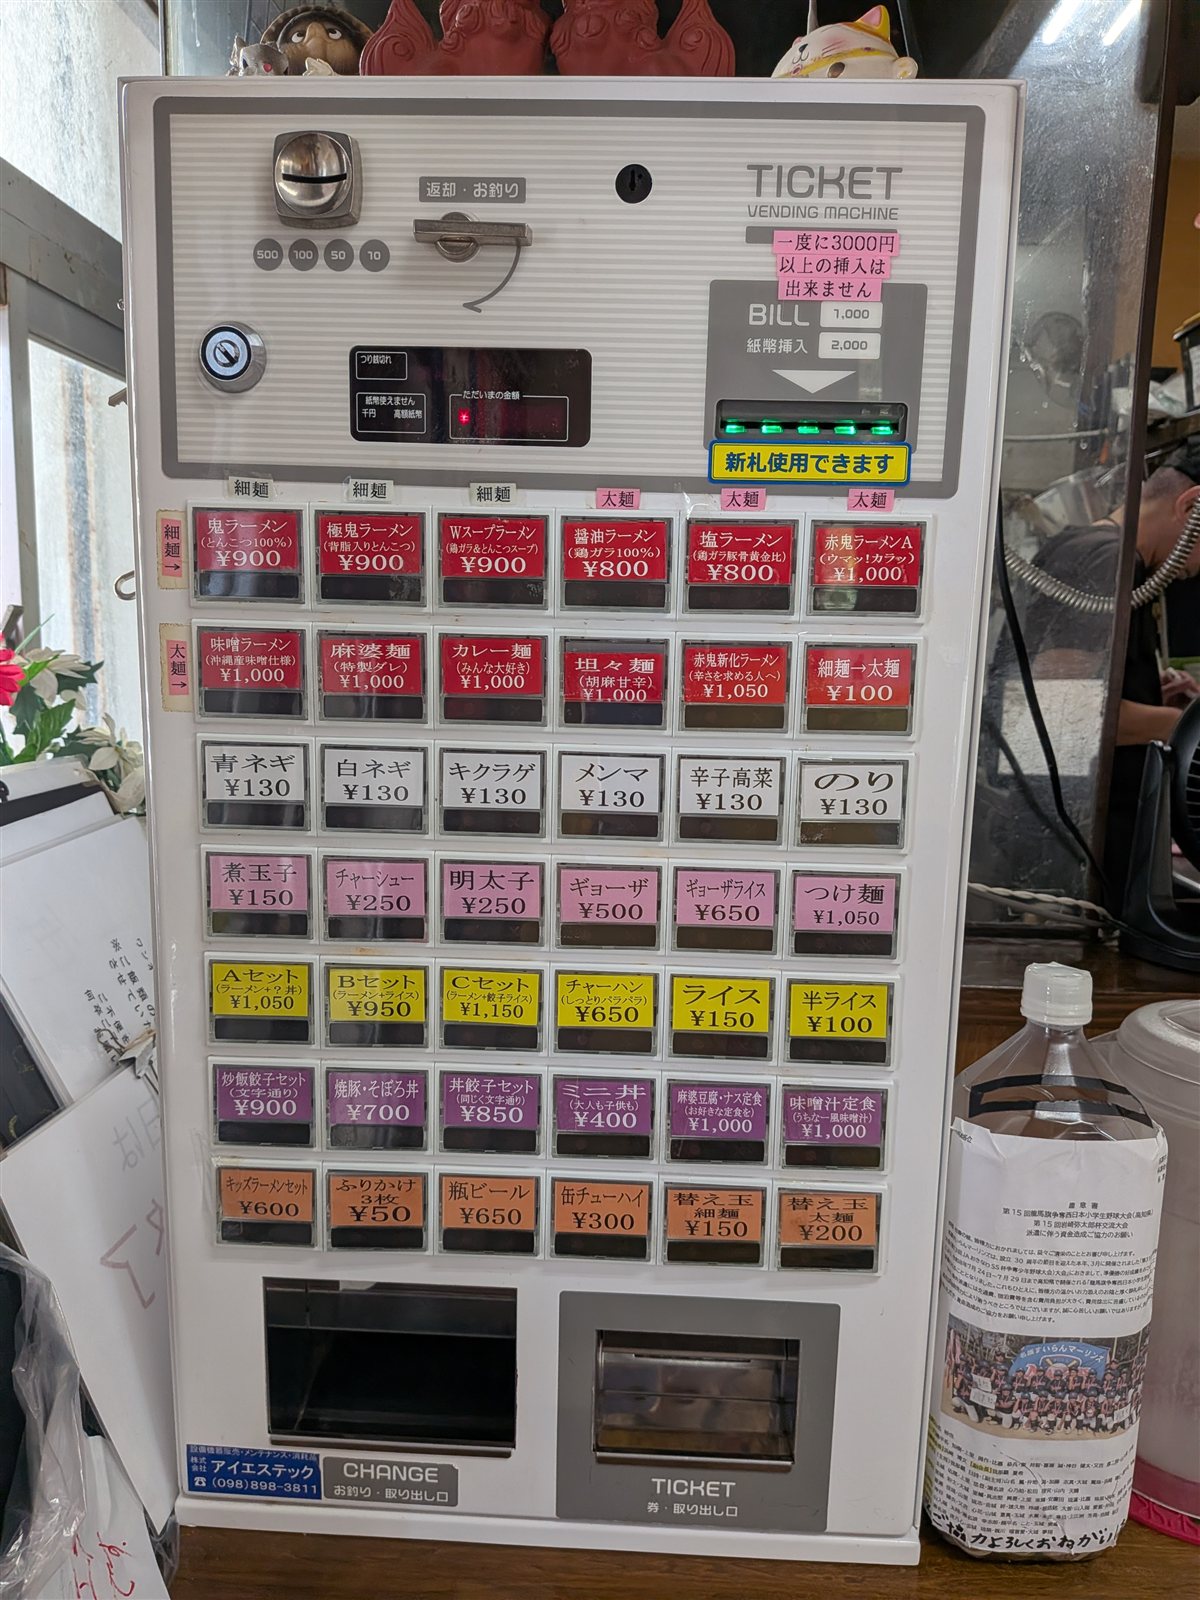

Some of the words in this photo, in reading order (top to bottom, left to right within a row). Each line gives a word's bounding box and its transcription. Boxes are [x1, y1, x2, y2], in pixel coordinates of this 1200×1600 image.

[747, 165, 903, 200] TICKET
[748, 205, 818, 218] VENDING
[824, 206, 899, 220] MACHINE
[778, 233, 894, 253] 一度に3000円
[257, 249, 278, 259] 500
[293, 250, 313, 259] 100
[331, 251, 346, 260] 50
[368, 251, 381, 260] 10
[779, 256, 885, 275] 以上の挿入は
[785, 280, 871, 298] 出来ません
[749, 304, 809, 326] BILL
[834, 309, 869, 319] 1,000
[747, 338, 808, 354] 紙幣挿入
[831, 340, 868, 351] 2,000
[365, 396, 415, 405] 紙幣使えません
[463, 390, 520, 400] ただいまの金額
[362, 409, 376, 418] 千円
[394, 409, 422, 419] 高額紙幣
[725, 452, 894, 474] 新札使用できます
[234, 480, 269, 497] 細麺
[353, 481, 387, 498] 細麺
[476, 486, 510, 502] 細麺
[602, 491, 634, 508] 太麺
[727, 491, 759, 507] 太麺
[854, 492, 886, 509] 太麺
[208, 518, 287, 533] 鬼ラーメン
[327, 522, 413, 538] 極鬼ラーメン
[450, 525, 536, 539] Wスープラーメン
[164, 525, 180, 558] 細麺
[574, 529, 656, 544] 醤油ラーメン
[700, 531, 783, 548] 塩ラーメン
[825, 534, 913, 549] 赤鬼ラーメンA
[216, 550, 281, 567] ¥900
[338, 555, 404, 570] ¥900
[461, 557, 526, 573] ¥900
[583, 561, 648, 577] ¥800
[707, 564, 773, 581] ¥800
[834, 567, 901, 582] ¥1,000
[211, 638, 291, 652] 味噌ラーメン
[330, 643, 411, 659] 麻婆麺
[452, 644, 532, 659] カレー麺
[170, 643, 186, 676] 太麺
[694, 653, 779, 668] 赤鬼新化ラーメン
[220, 668, 284, 683] ¥1,000
[456, 662, 530, 675] (みんな大好き)
[339, 675, 404, 689] ¥1,000
[460, 675, 525, 690] ¥1,000
[703, 684, 768, 699] ¥1,050
[827, 686, 892, 701] ¥100
[210, 754, 295, 773] 青ネギ
[337, 760, 411, 779] 白ネギ
[449, 762, 535, 782] キクラゲ
[575, 763, 649, 783] メンマ
[690, 767, 773, 788] 辛子高菜
[224, 779, 290, 797] ¥130
[814, 771, 893, 793] のり
[343, 784, 408, 801] ¥130
[461, 788, 526, 805] ¥130
[579, 790, 645, 807] ¥130
[697, 793, 762, 810] ¥130
[821, 798, 887, 815] ¥130
[222, 862, 296, 883] 煮玉子
[335, 868, 414, 888] チャーシュー
[450, 870, 534, 891] 明太子
[569, 878, 648, 897] ギョーザ
[686, 879, 766, 899] ギョーザライス
[804, 884, 885, 905] つけ麺
[229, 890, 293, 906] ¥150
[346, 895, 411, 912] ¥250
[462, 897, 526, 914] ¥250
[579, 904, 643, 920] ¥500
[695, 905, 760, 921] ¥650
[814, 910, 880, 926] ¥1,050
[221, 969, 298, 983] Aセット
[338, 975, 415, 989] Bセット
[452, 976, 528, 993] Cセット
[566, 980, 643, 994] チャーハン
[230, 996, 294, 1010] ¥1,050
[683, 985, 761, 1006] ライス
[802, 991, 876, 1011] 半ライス
[348, 1001, 411, 1017] ¥950
[460, 1003, 523, 1018] ¥1,150
[576, 1006, 639, 1023] ¥650
[690, 1010, 754, 1028] ¥150
[807, 1016, 872, 1033] ¥100
[222, 1072, 306, 1088] 炒飯餃子セット
[449, 1078, 533, 1094] 丼餃子セット
[562, 1084, 646, 1100] ミニ丼
[234, 1099, 297, 1116] ¥900
[346, 1104, 409, 1121] ¥700
[790, 1097, 876, 1112] 味噌汁定食
[461, 1106, 523, 1123] ¥850
[574, 1111, 637, 1128] ¥400
[689, 1118, 752, 1133] ¥1,000
[802, 1124, 866, 1139] ¥1,000
[226, 1176, 308, 1195] キッズラーメンセット
[336, 1179, 416, 1192] ふりかけ
[448, 1181, 530, 1201] 瓶ビール
[361, 1194, 400, 1205] 3枚
[561, 1186, 643, 1208] 缶チューハイ
[673, 1193, 753, 1206] 替え玉
[787, 1197, 868, 1211] 替え玉
[240, 1202, 299, 1217] ¥600
[348, 1206, 411, 1222] ¥50
[460, 1208, 522, 1224] ¥650
[694, 1208, 739, 1218] 細麺
[809, 1212, 853, 1223] 太麺
[572, 1212, 634, 1230] ¥300
[685, 1220, 747, 1237] ¥150
[799, 1224, 863, 1241] ¥200
[211, 1460, 313, 1479] アイエステック
[344, 1463, 439, 1483] CHANGE
[212, 1478, 317, 1493] (098)898-3811
[652, 1479, 736, 1497] TICKET
